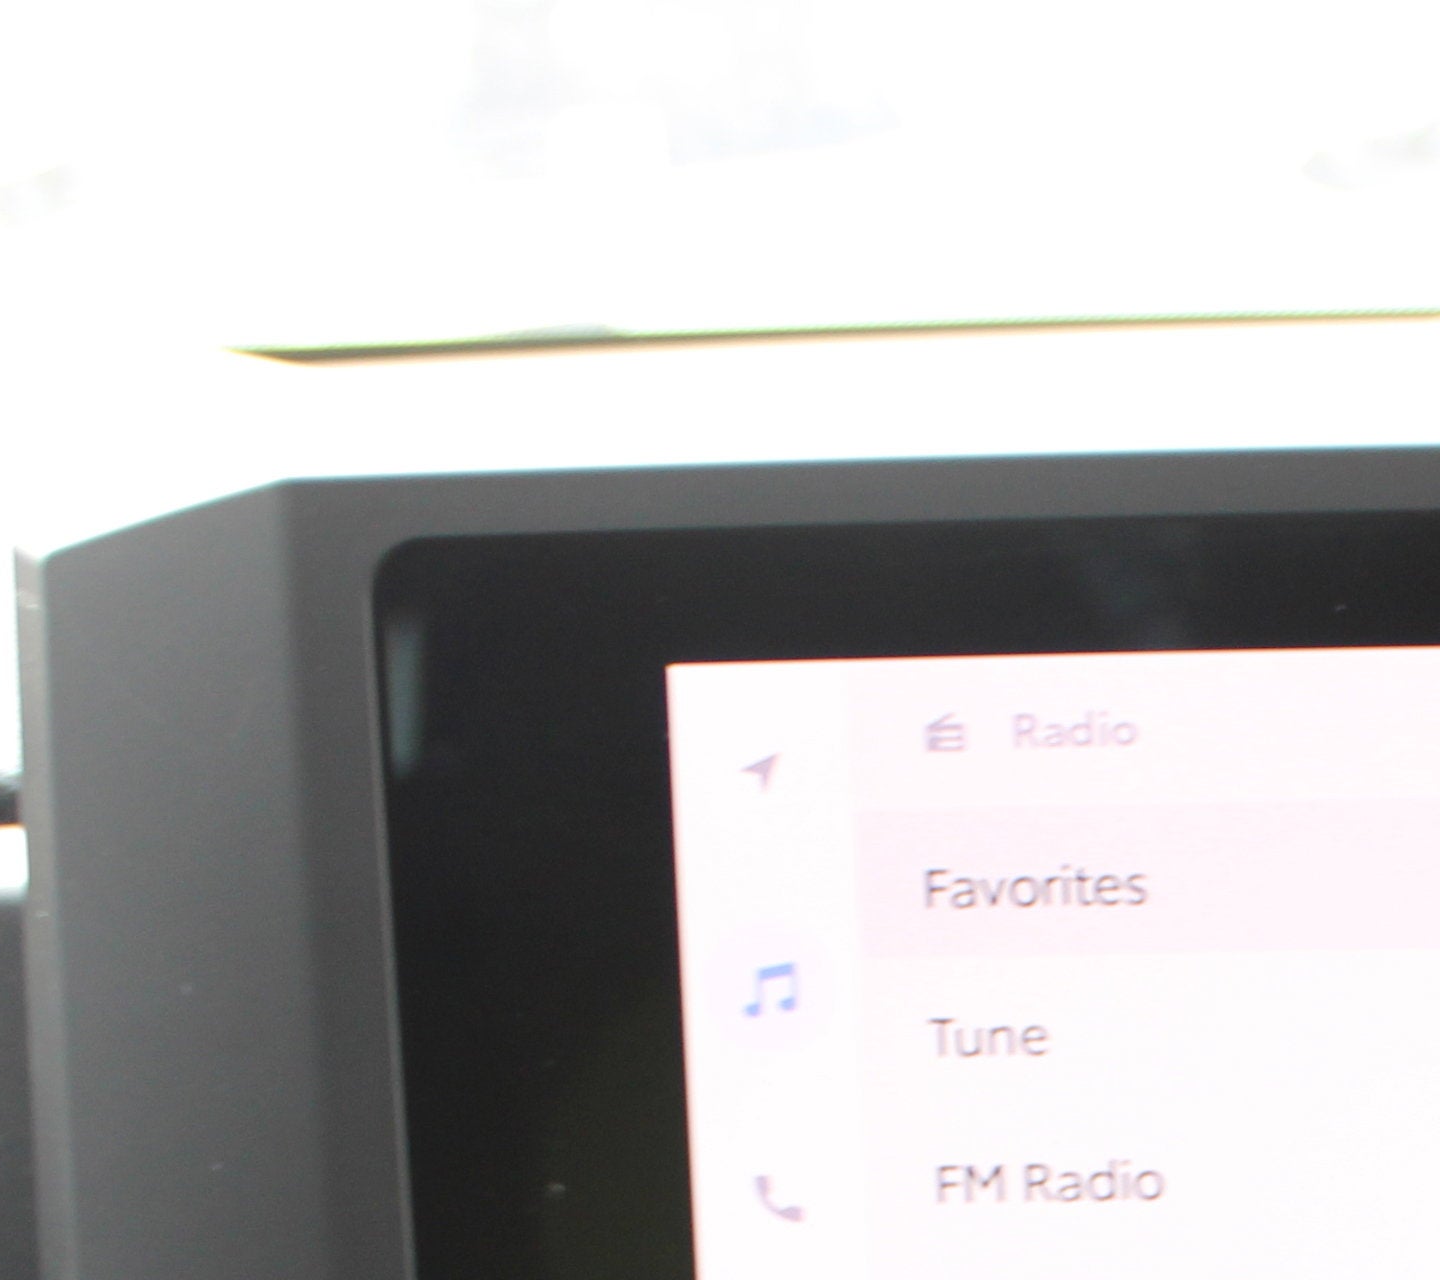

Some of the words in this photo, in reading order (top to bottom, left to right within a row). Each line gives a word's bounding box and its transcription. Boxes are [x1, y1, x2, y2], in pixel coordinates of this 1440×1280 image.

[1012, 711, 1139, 748] Radio
[924, 865, 1147, 910] Favorites
[927, 1017, 1049, 1058] Tune
[937, 1165, 1004, 1202] FM
[1024, 1160, 1164, 1203] Radio
